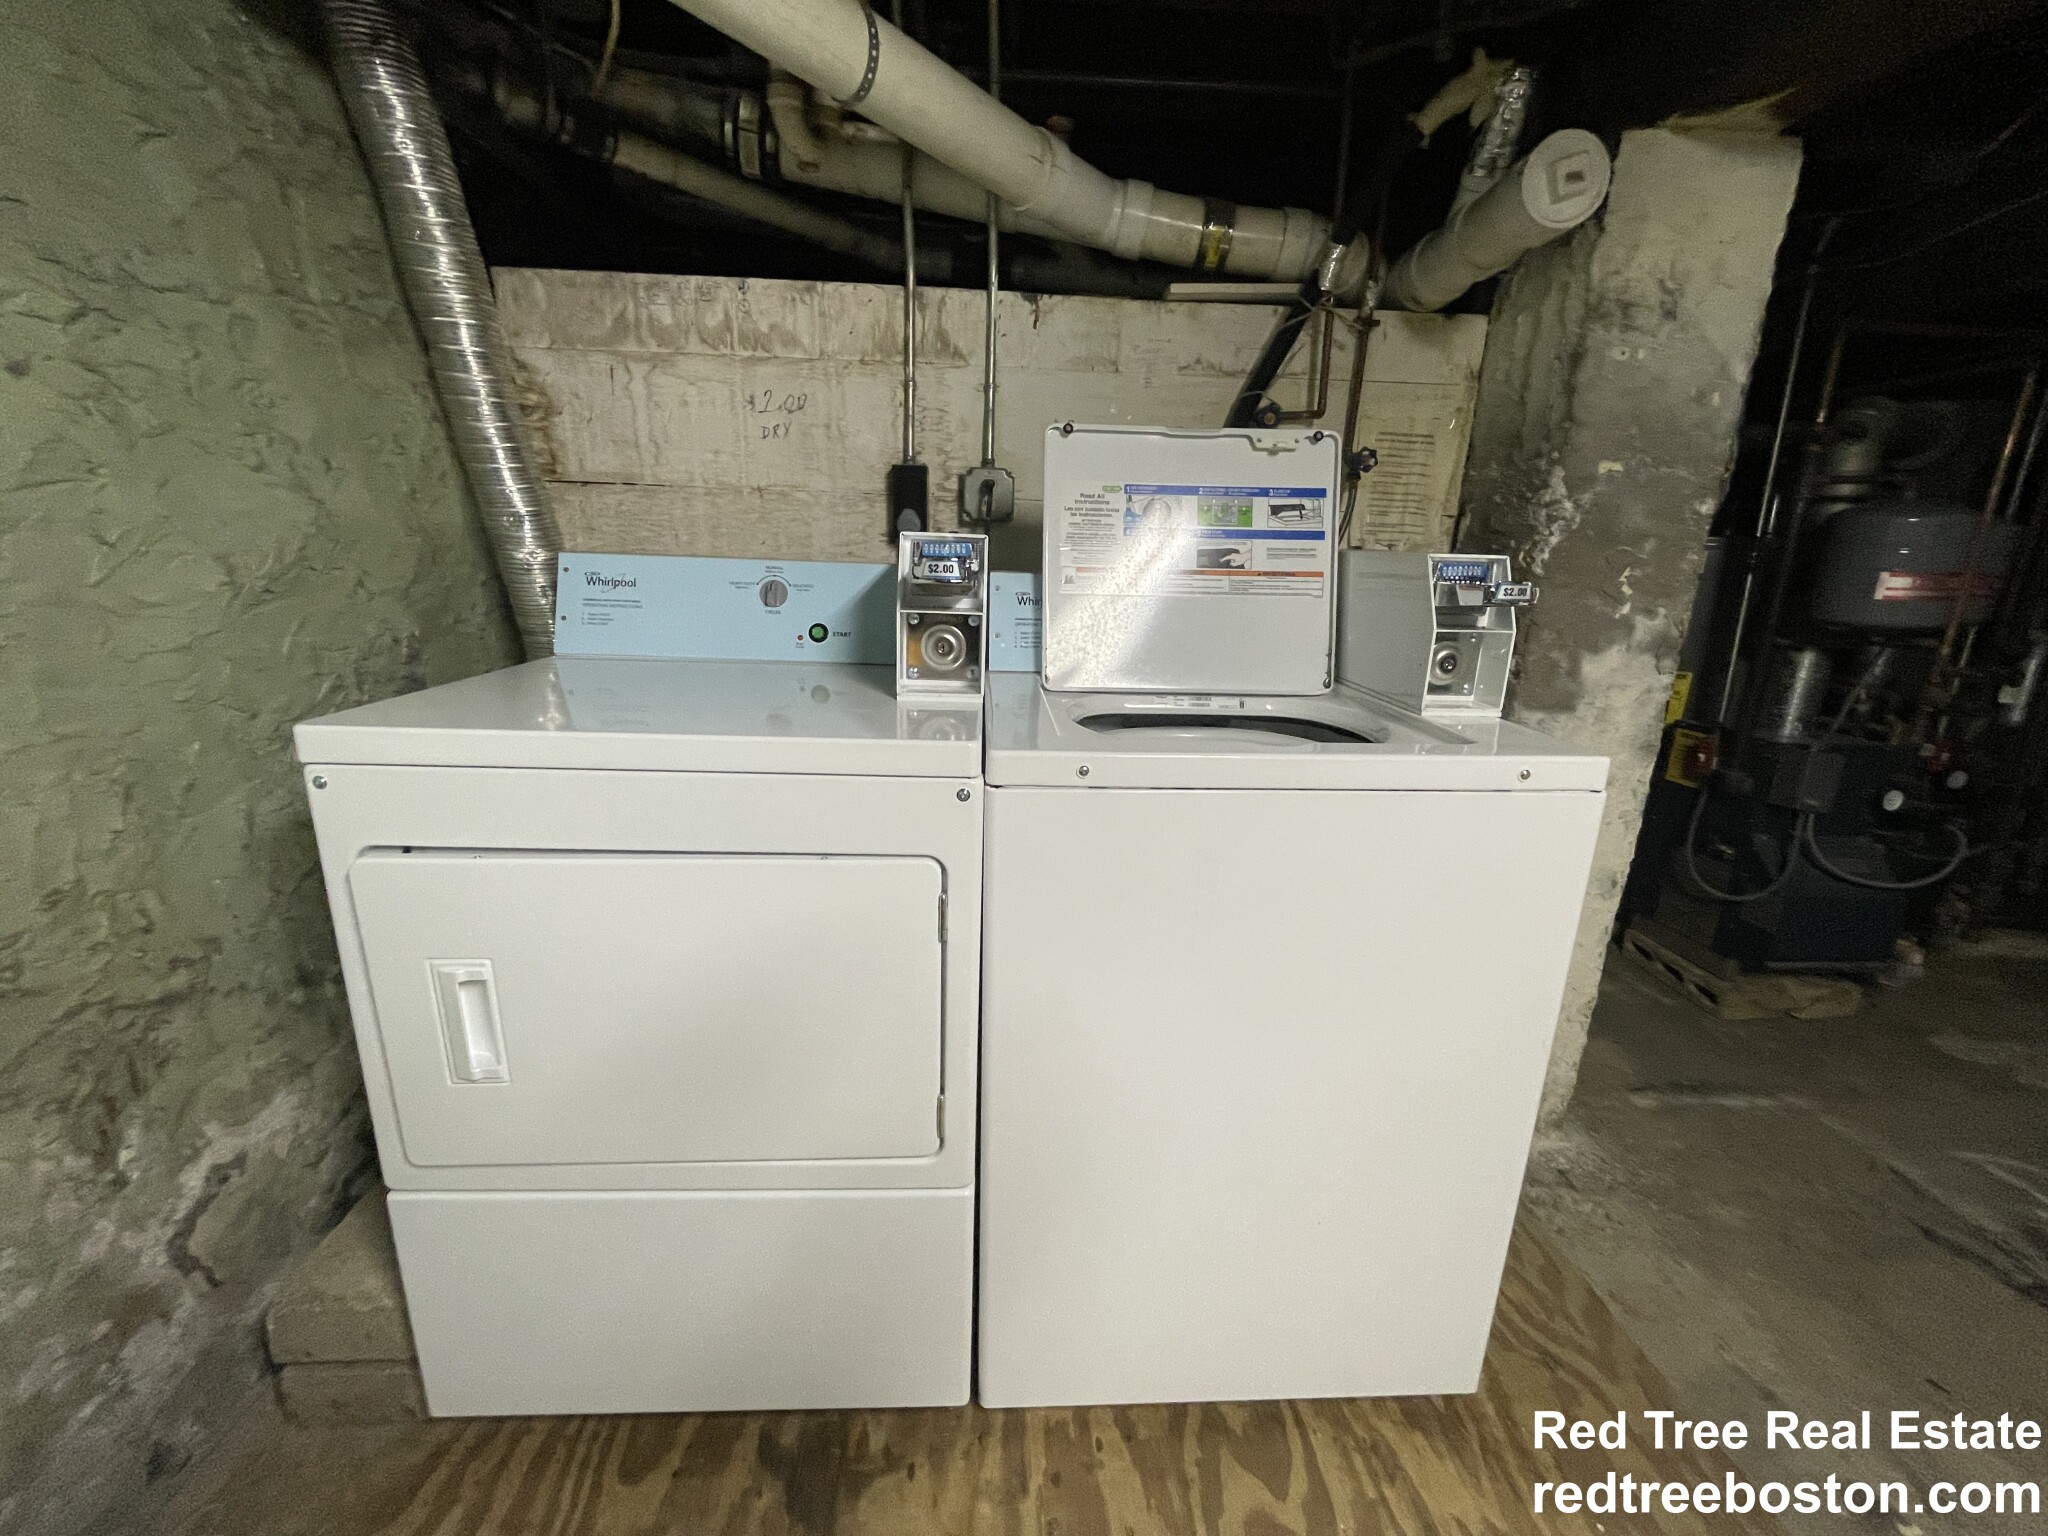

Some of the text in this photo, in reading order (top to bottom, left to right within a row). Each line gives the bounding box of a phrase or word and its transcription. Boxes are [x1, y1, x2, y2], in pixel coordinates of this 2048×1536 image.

[760, 421, 793, 440] DRY
[928, 563, 954, 574] $2.00
[586, 576, 637, 590] Whirlpool
[1503, 587, 1528, 597] $2.00
